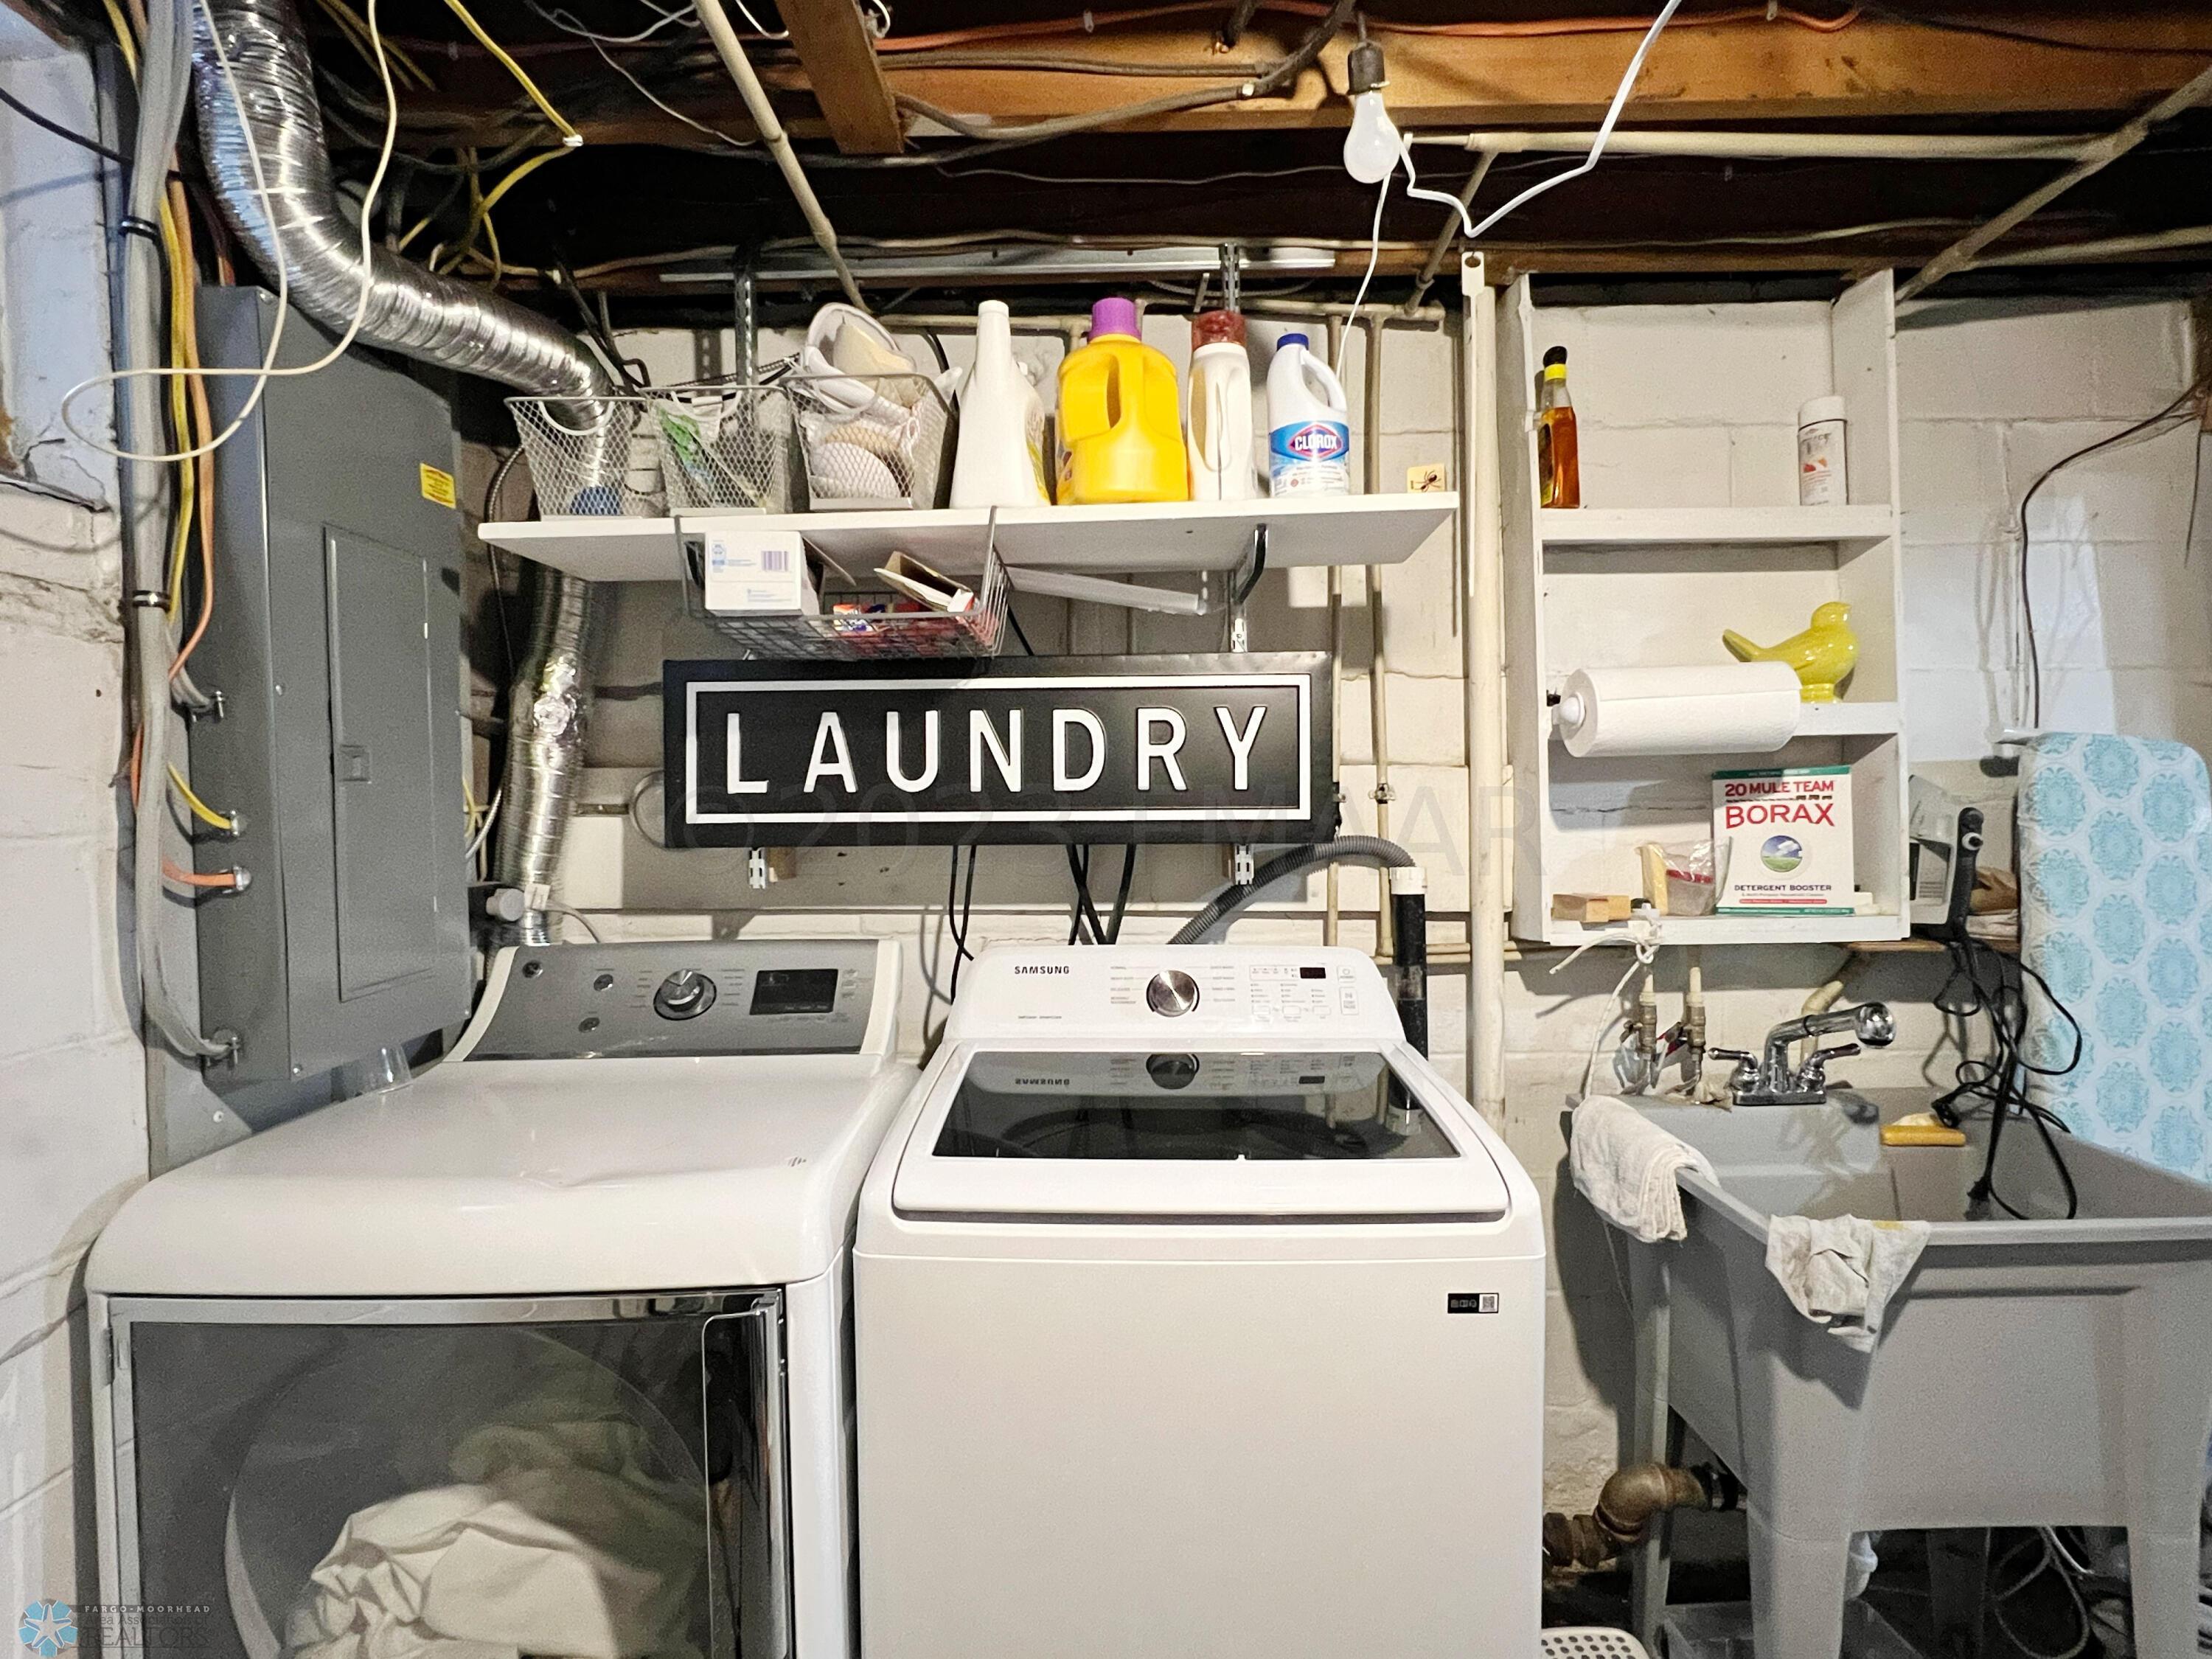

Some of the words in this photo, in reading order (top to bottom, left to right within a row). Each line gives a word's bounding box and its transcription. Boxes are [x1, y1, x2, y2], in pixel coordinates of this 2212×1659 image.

[1295, 434, 1338, 451] CLOROX
[725, 705, 1268, 796] LAUNDRY
[1725, 783, 1747, 797] 20
[1749, 782, 1790, 794] MULE
[1793, 780, 1834, 793] TEAM
[1725, 803, 1834, 830] BORAX
[1015, 966, 1069, 975] SAMSUNG
